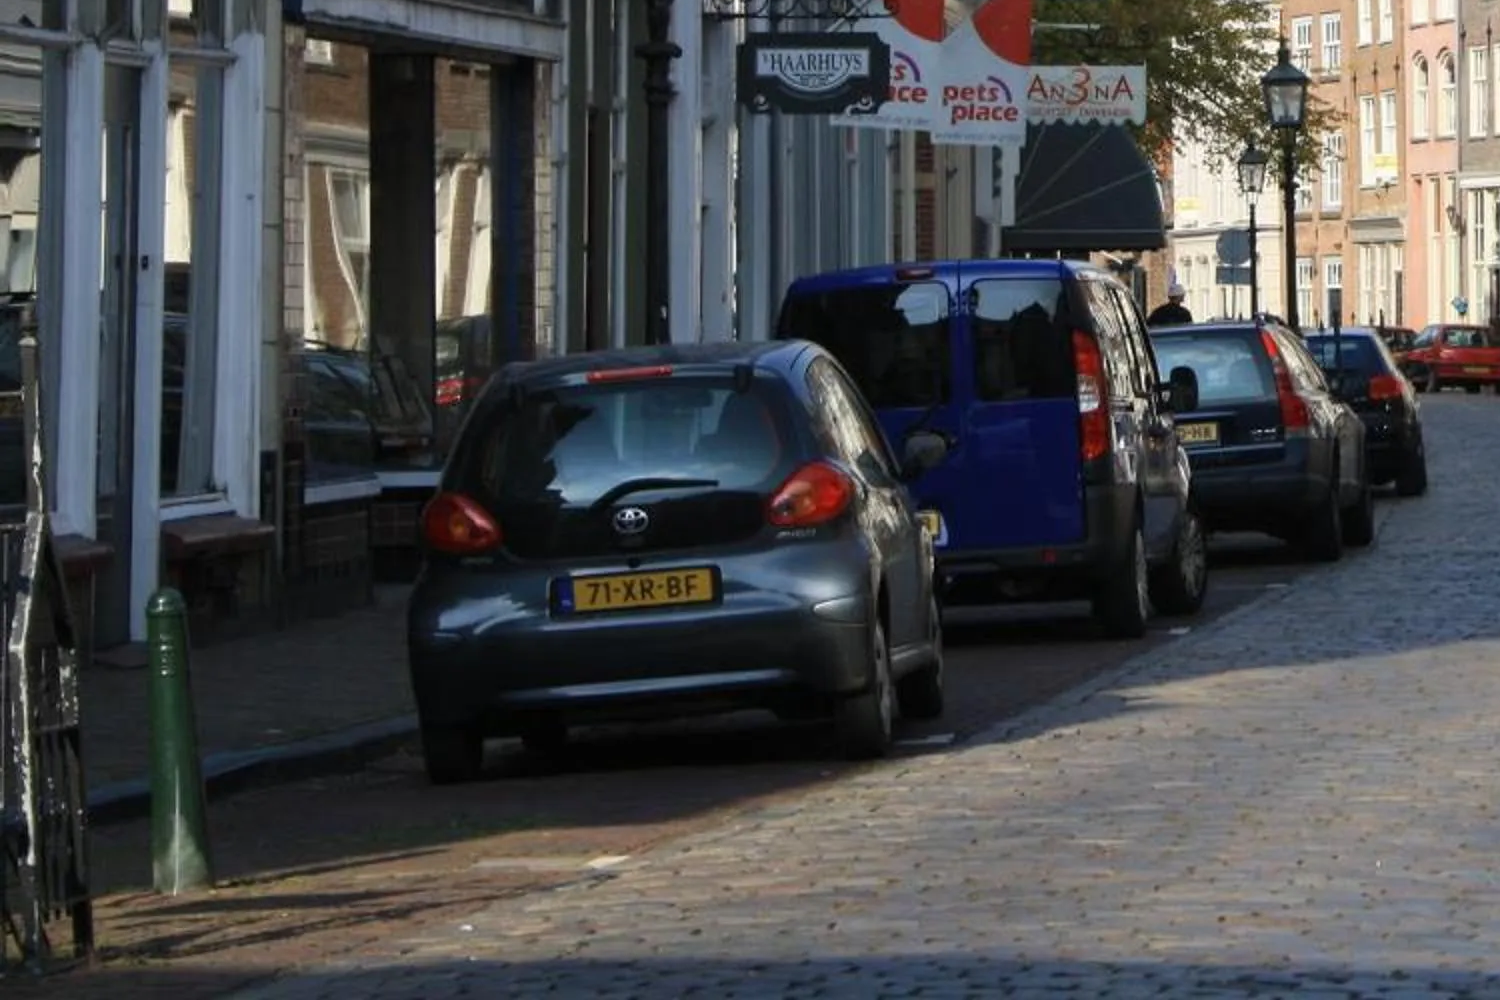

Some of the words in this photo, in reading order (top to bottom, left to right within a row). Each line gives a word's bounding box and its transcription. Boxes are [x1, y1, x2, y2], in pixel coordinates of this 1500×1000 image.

[770, 52, 863, 73] HAARHUYS
[942, 83, 1000, 106] pets
[951, 102, 1019, 125] place
[585, 574, 698, 605] 71-XR-BF
